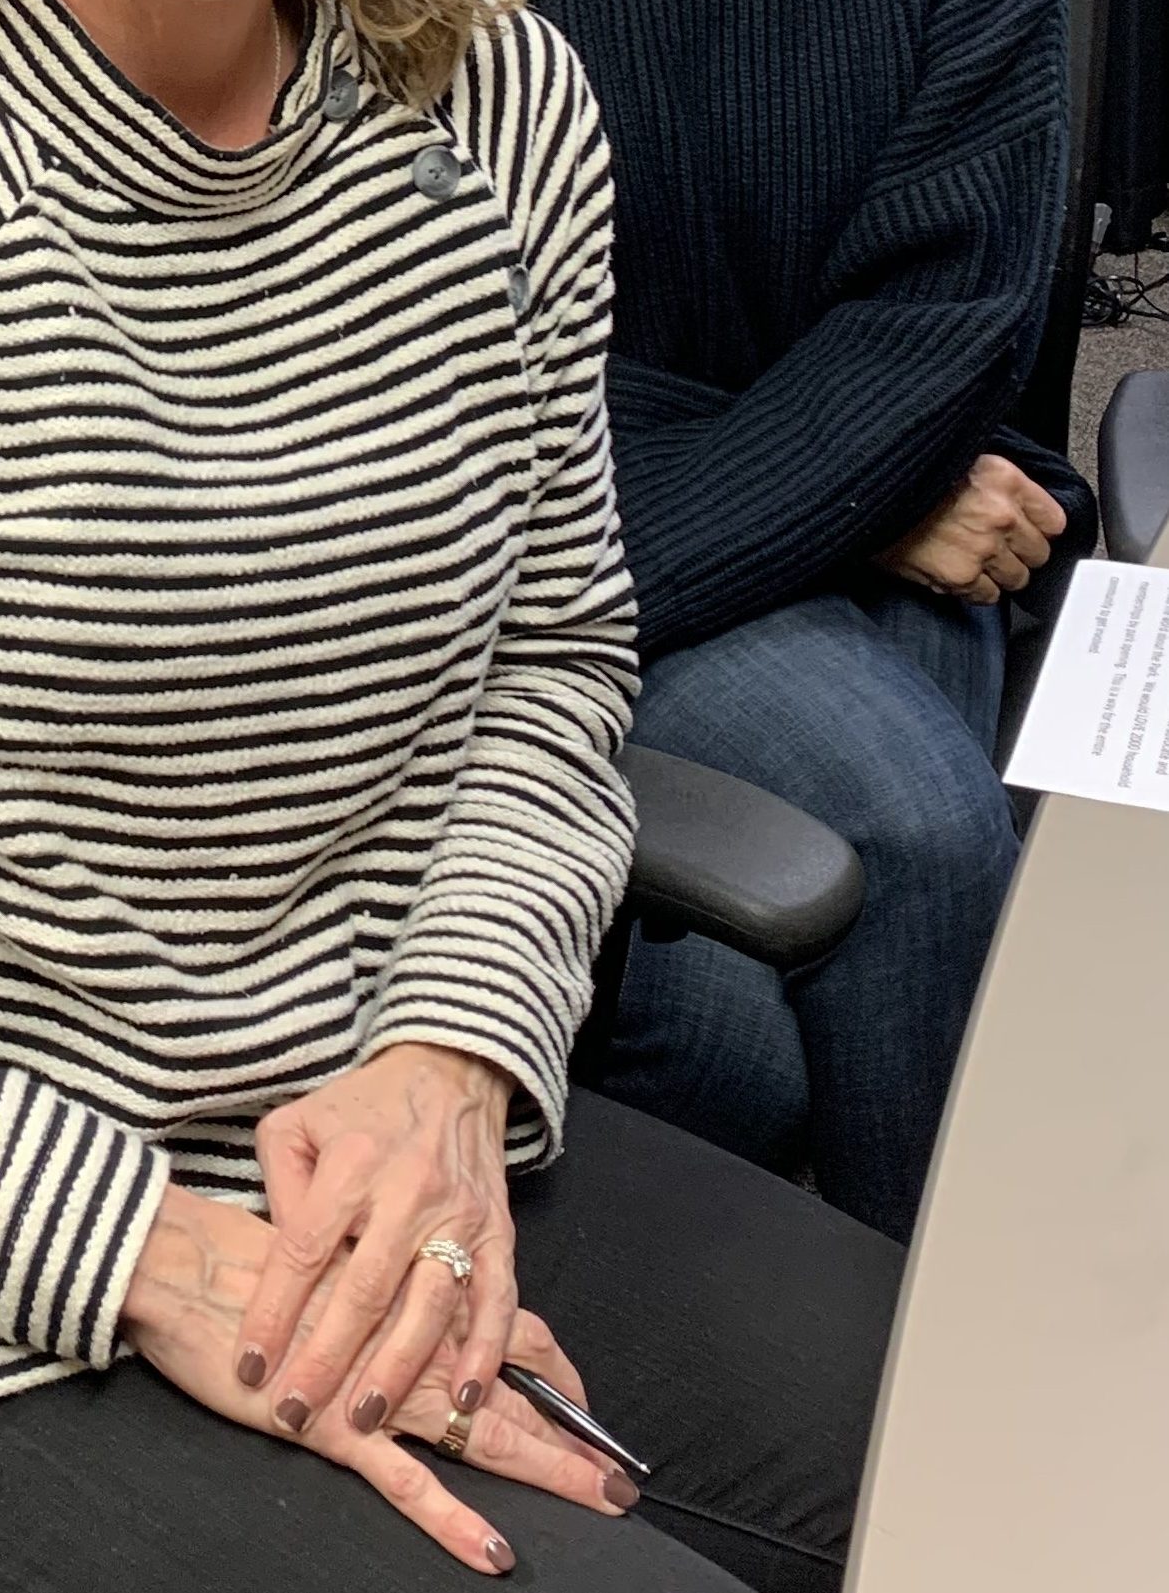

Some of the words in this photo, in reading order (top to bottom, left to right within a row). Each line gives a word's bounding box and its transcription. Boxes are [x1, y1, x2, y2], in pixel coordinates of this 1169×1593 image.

[1100, 576, 1120, 609] community
[1095, 616, 1109, 627] get
[1127, 620, 1139, 628] by
[1125, 628, 1137, 642] park
[1142, 682, 1157, 693] We
[1103, 698, 1117, 711] way
[1137, 694, 1151, 714] would
[1101, 711, 1116, 722] for
[1132, 714, 1149, 732] LOVE
[1098, 722, 1112, 734] the
[1127, 732, 1145, 751] 2000
[1117, 751, 1139, 789] household
